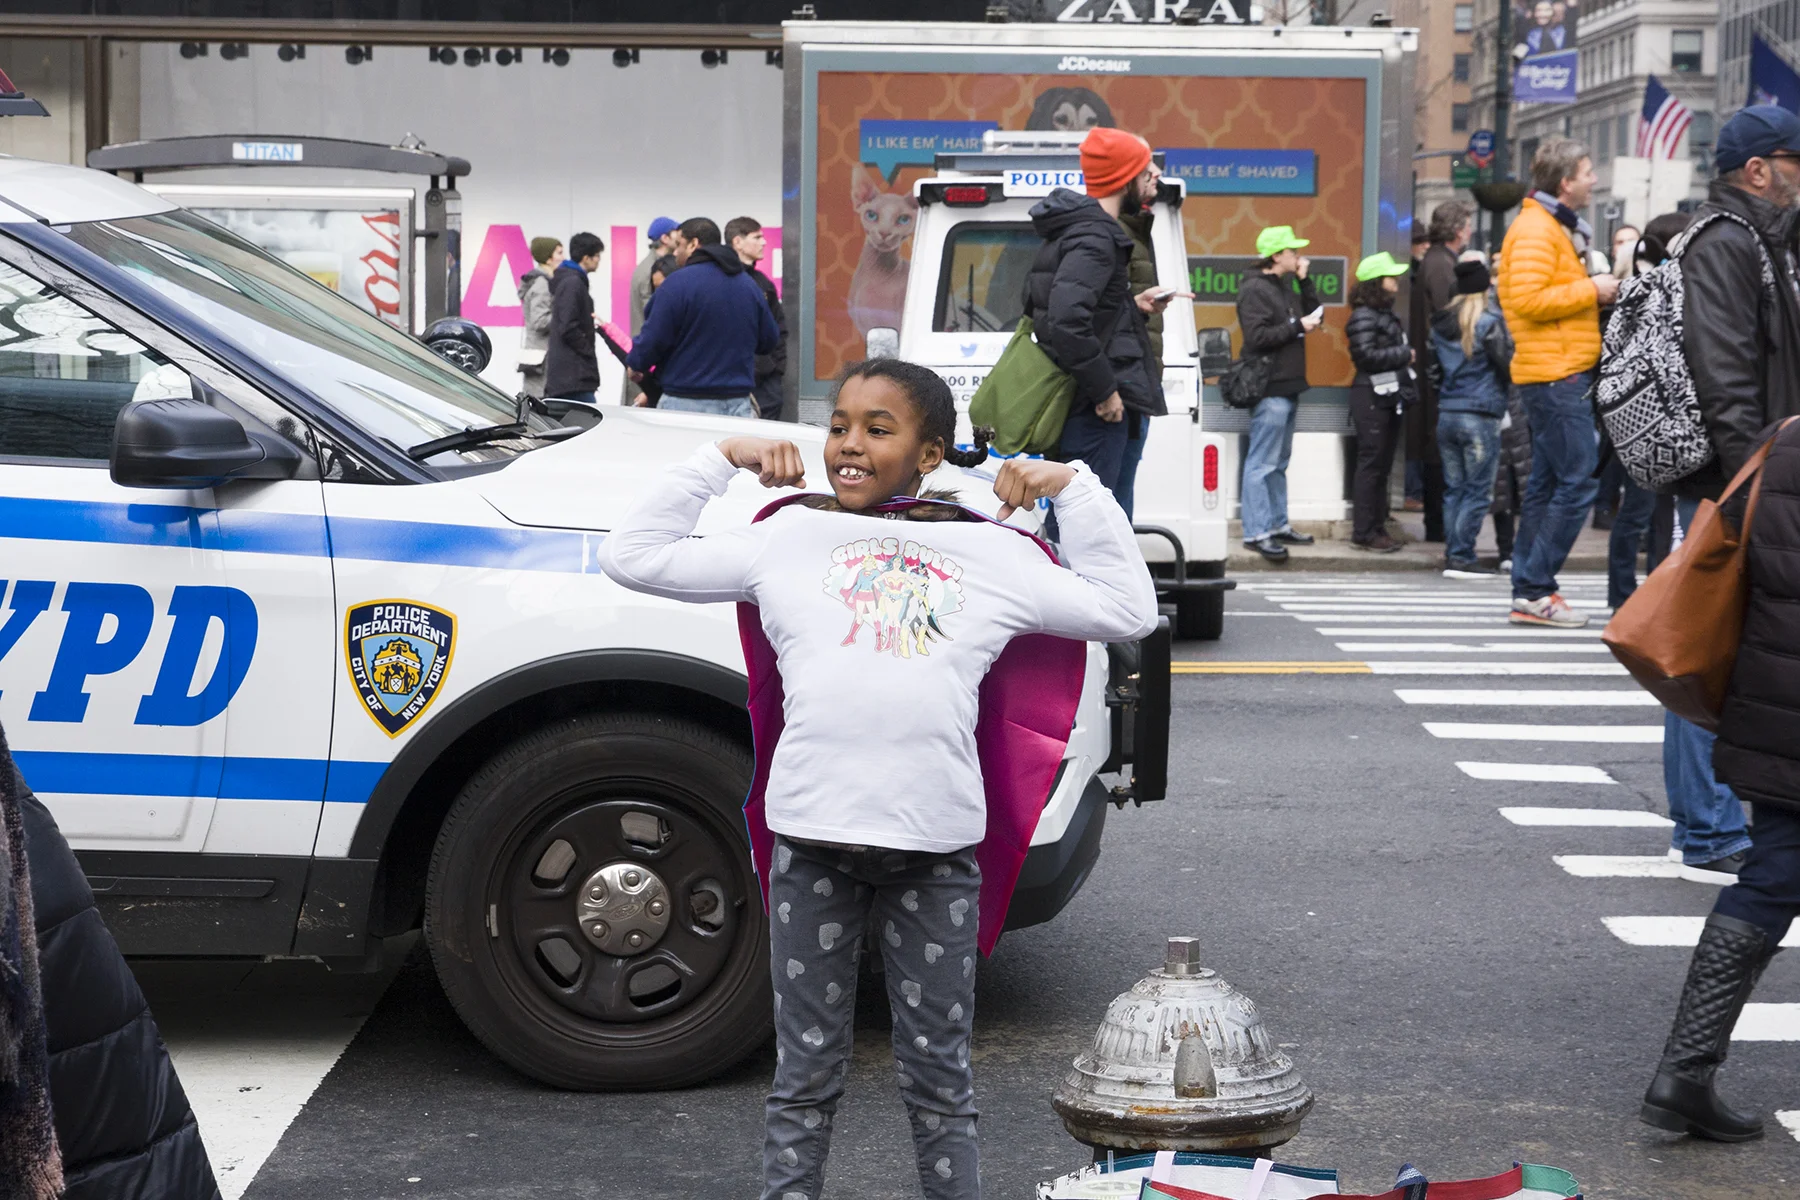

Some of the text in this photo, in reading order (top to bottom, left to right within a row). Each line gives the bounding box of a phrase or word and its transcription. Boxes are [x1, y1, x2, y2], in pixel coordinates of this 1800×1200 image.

[1056, 0, 1245, 23] ZARA
[1057, 56, 1131, 72] JCDecaux
[241, 143, 295, 161] TITAN
[876, 136, 909, 149] LIKE
[943, 137, 984, 149] HAIR
[1171, 165, 1203, 178] LIKE
[1238, 165, 1298, 178] SHAVED
[831, 537, 900, 564] GIRLS
[373, 605, 431, 625] POLICE
[352, 619, 448, 647] DEPARTMENT
[352, 657, 382, 711] CITY OF
[402, 655, 447, 721] NEW YORK
